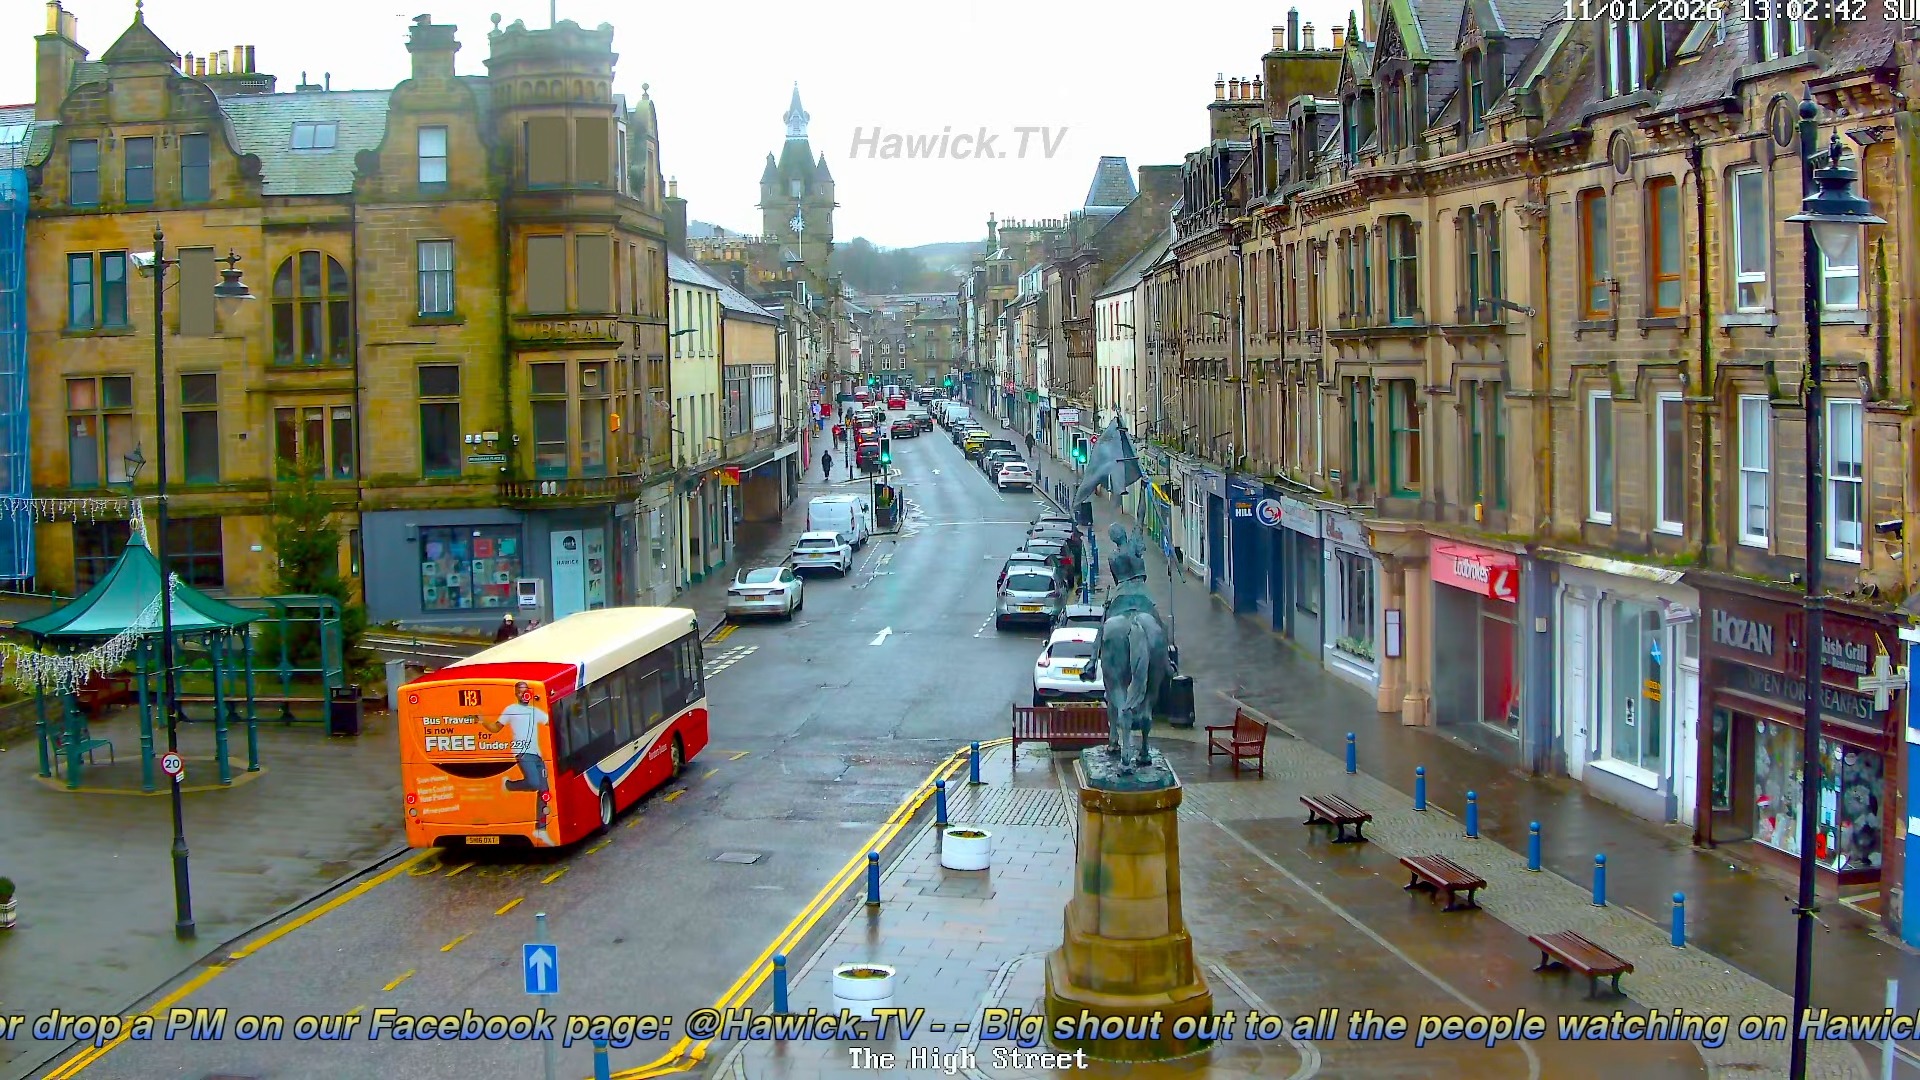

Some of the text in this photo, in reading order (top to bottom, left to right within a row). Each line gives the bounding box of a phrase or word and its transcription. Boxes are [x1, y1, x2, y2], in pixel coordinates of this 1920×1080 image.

[1235, 508, 1252, 517] HILL
[1454, 555, 1489, 584] Ladbrokes
[1711, 608, 1772, 656] HOZAN
[1821, 636, 1843, 657] kish
[1845, 641, 1867, 663] Grill
[464, 690, 477, 706] H3
[1820, 689, 1876, 721] REAKFAST
[423, 717, 441, 726] Bus
[434, 727, 454, 735] now
[478, 731, 492, 740] for
[425, 736, 476, 752] FREE
[479, 741, 508, 750] Under
[165, 759, 180, 769] 20
